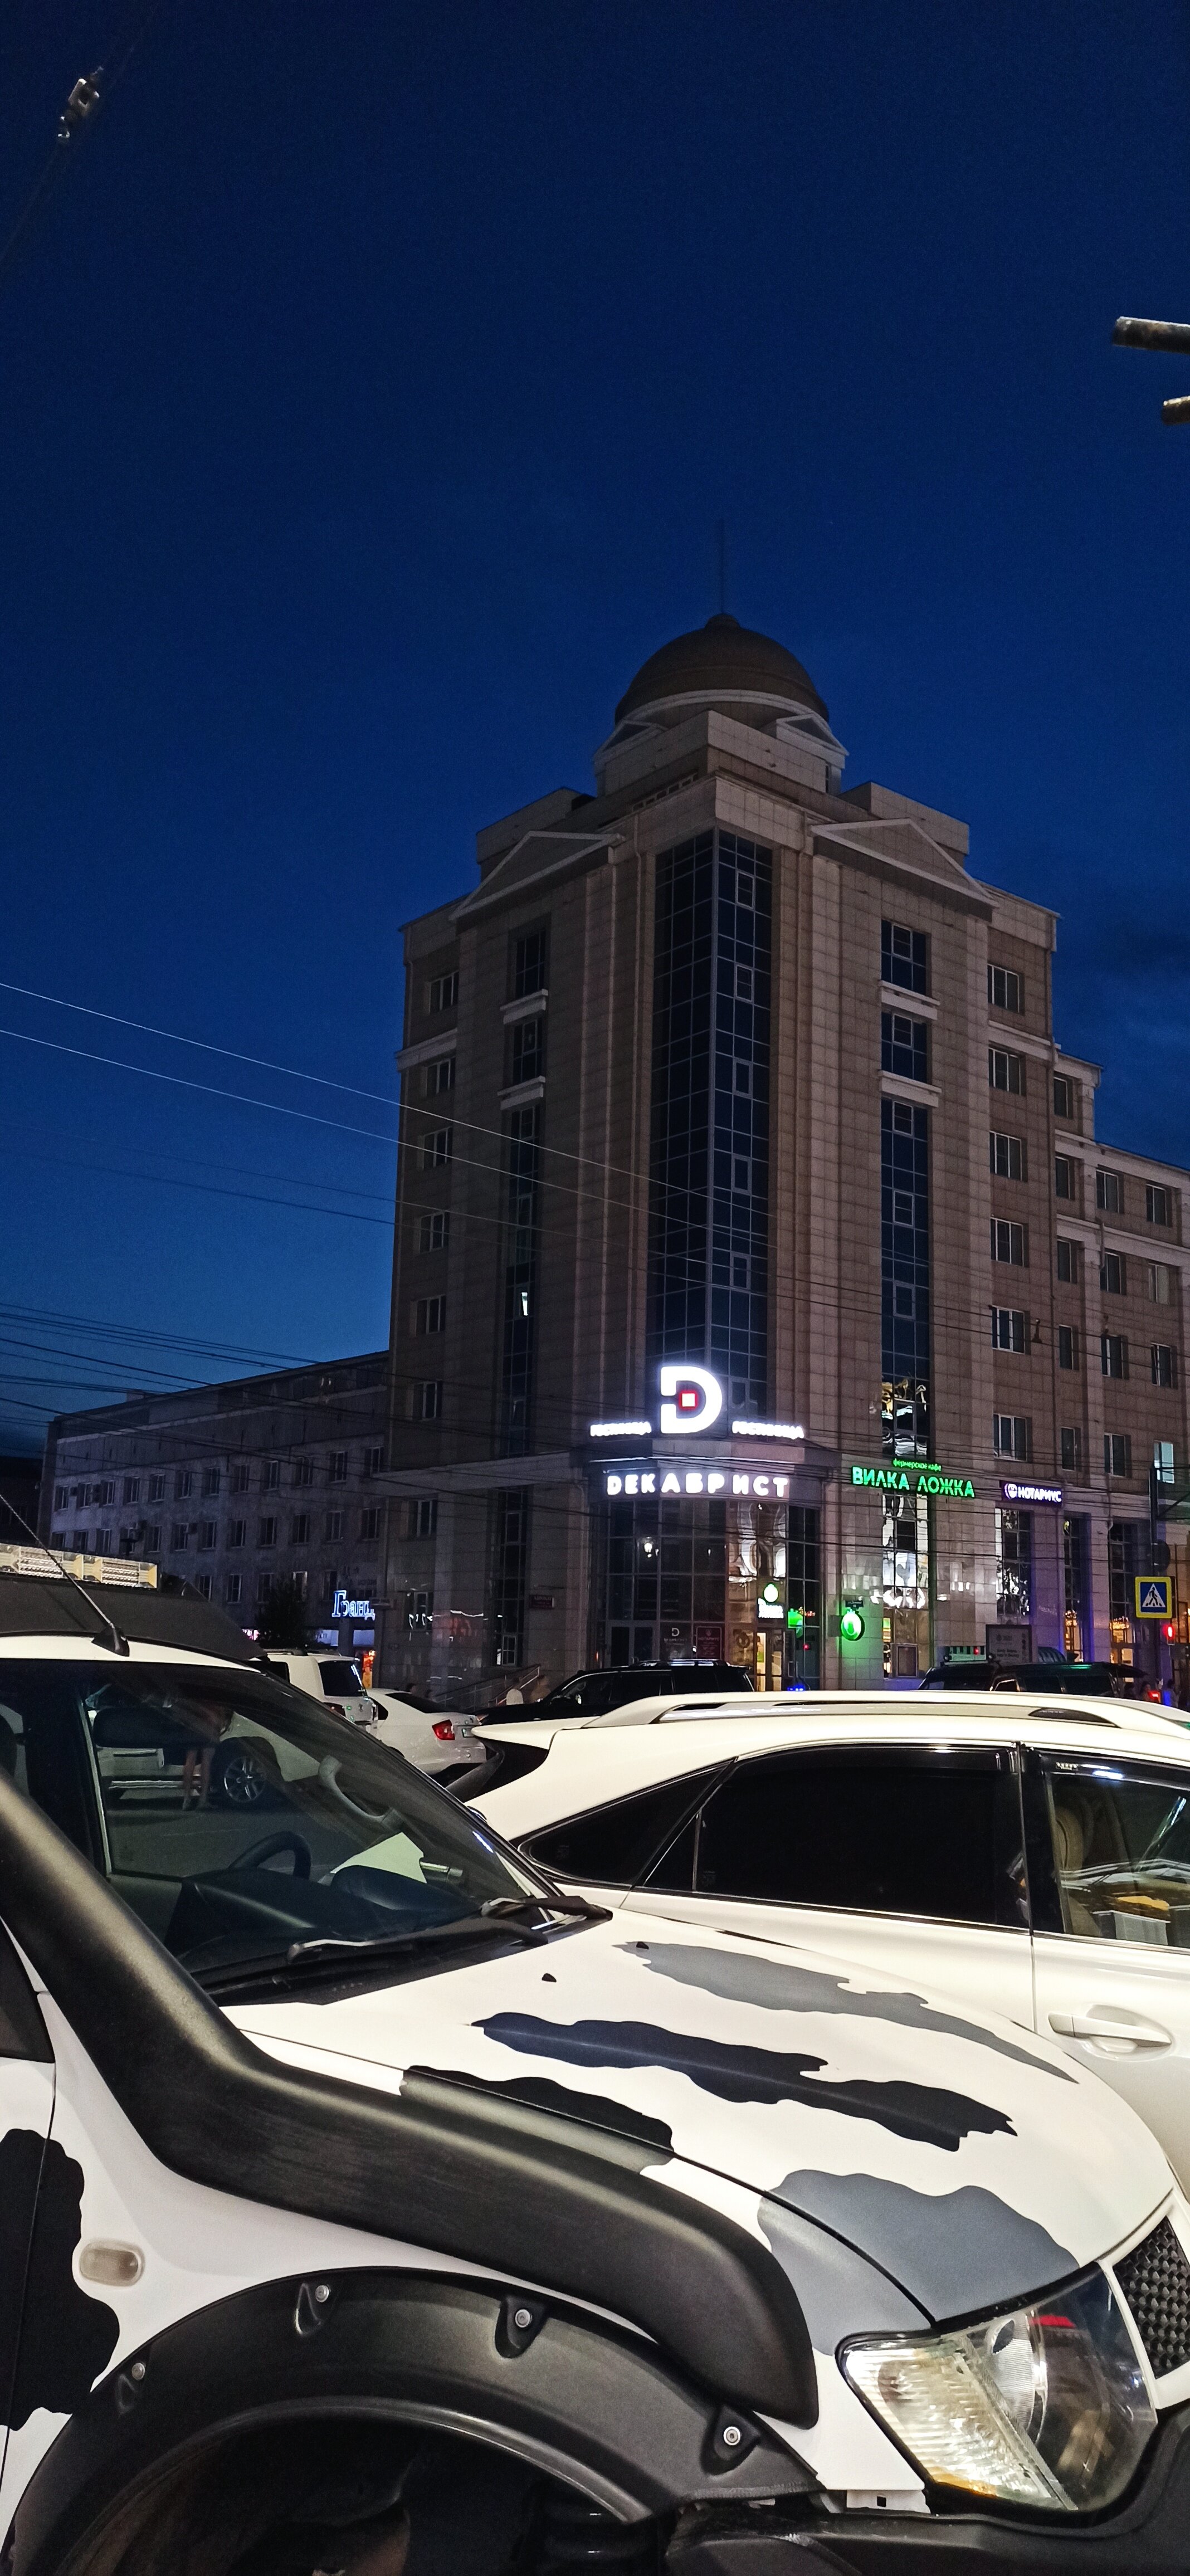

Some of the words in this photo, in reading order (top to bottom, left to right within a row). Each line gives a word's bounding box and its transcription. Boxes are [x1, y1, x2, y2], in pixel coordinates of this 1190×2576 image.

[928, 1463, 942, 1472] кафе
[852, 1467, 910, 1490] ВИЛКА
[918, 1476, 975, 1497] ЛОЖКА
[1018, 1486, 1061, 1502] НОТАРИУС
